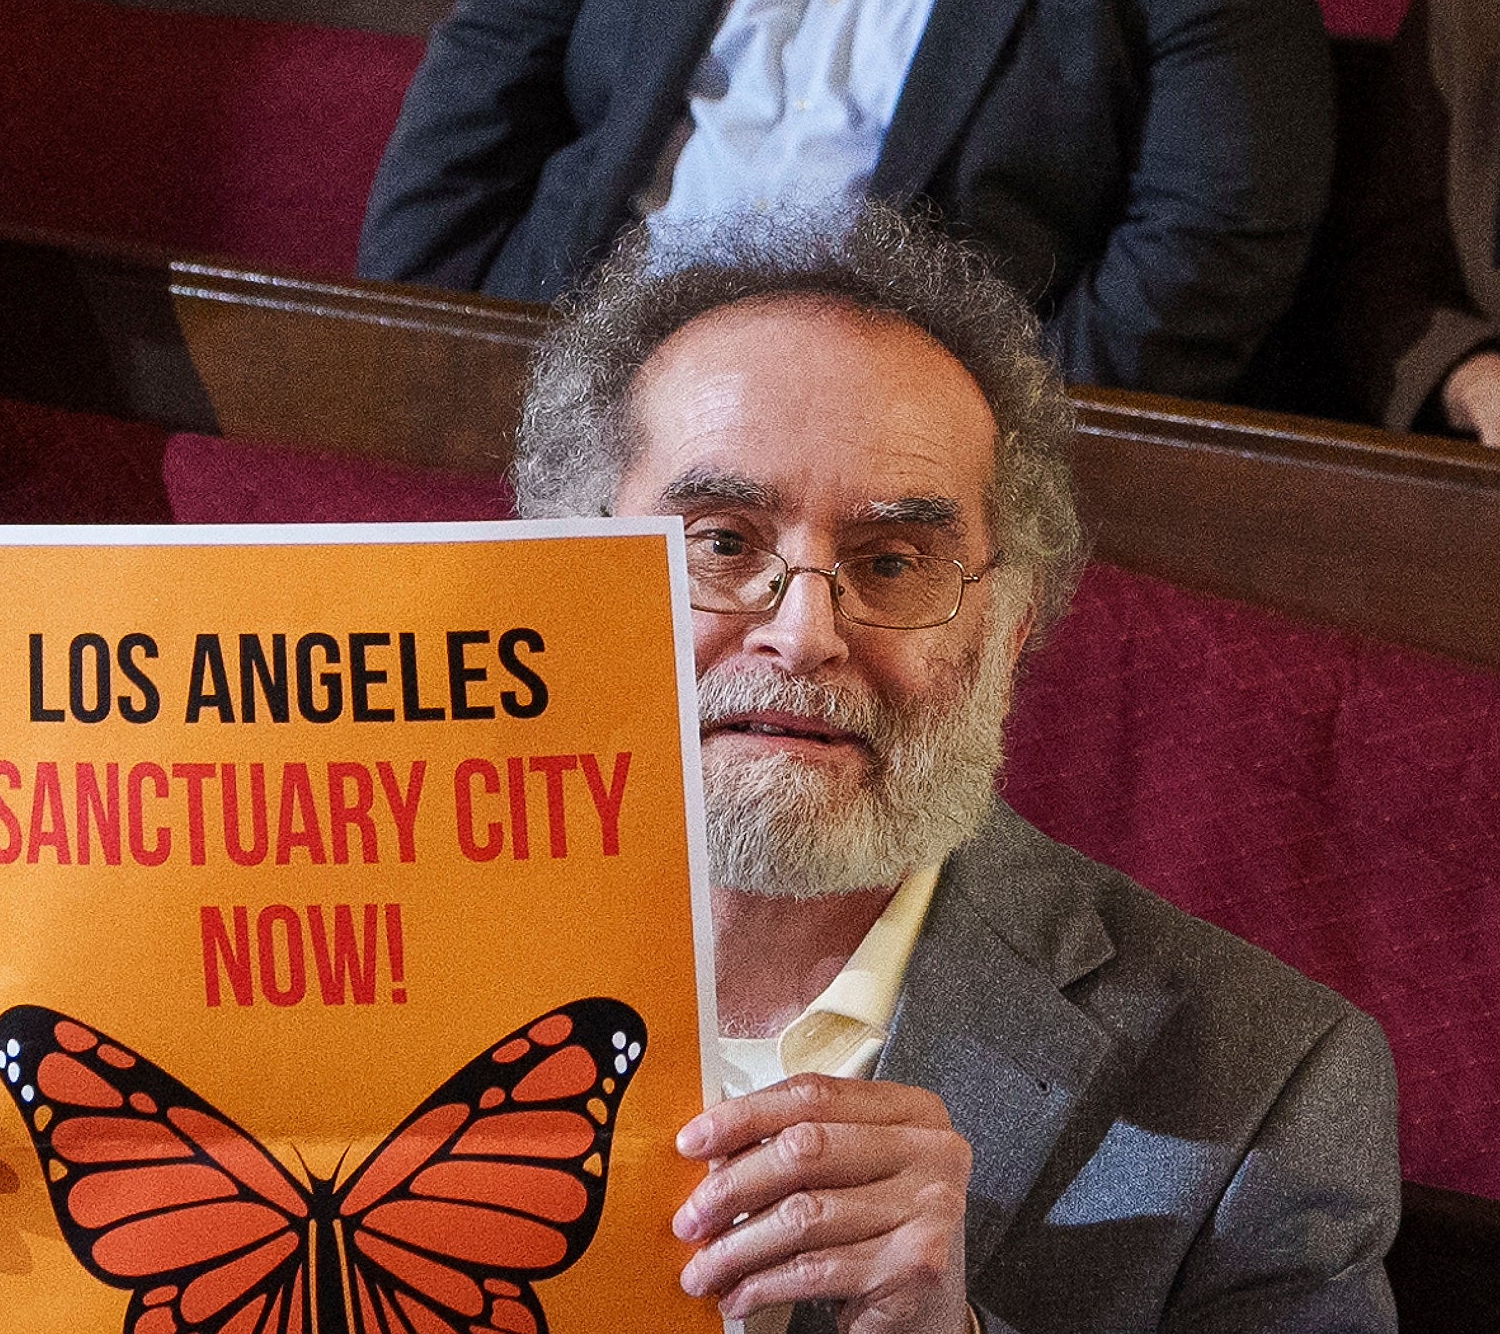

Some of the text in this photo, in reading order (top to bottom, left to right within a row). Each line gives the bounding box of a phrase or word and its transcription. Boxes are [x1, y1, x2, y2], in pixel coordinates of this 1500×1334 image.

[28, 628, 550, 725] LOS ANGELES
[454, 751, 632, 864] CITY
[200, 904, 408, 1008] NOW!
